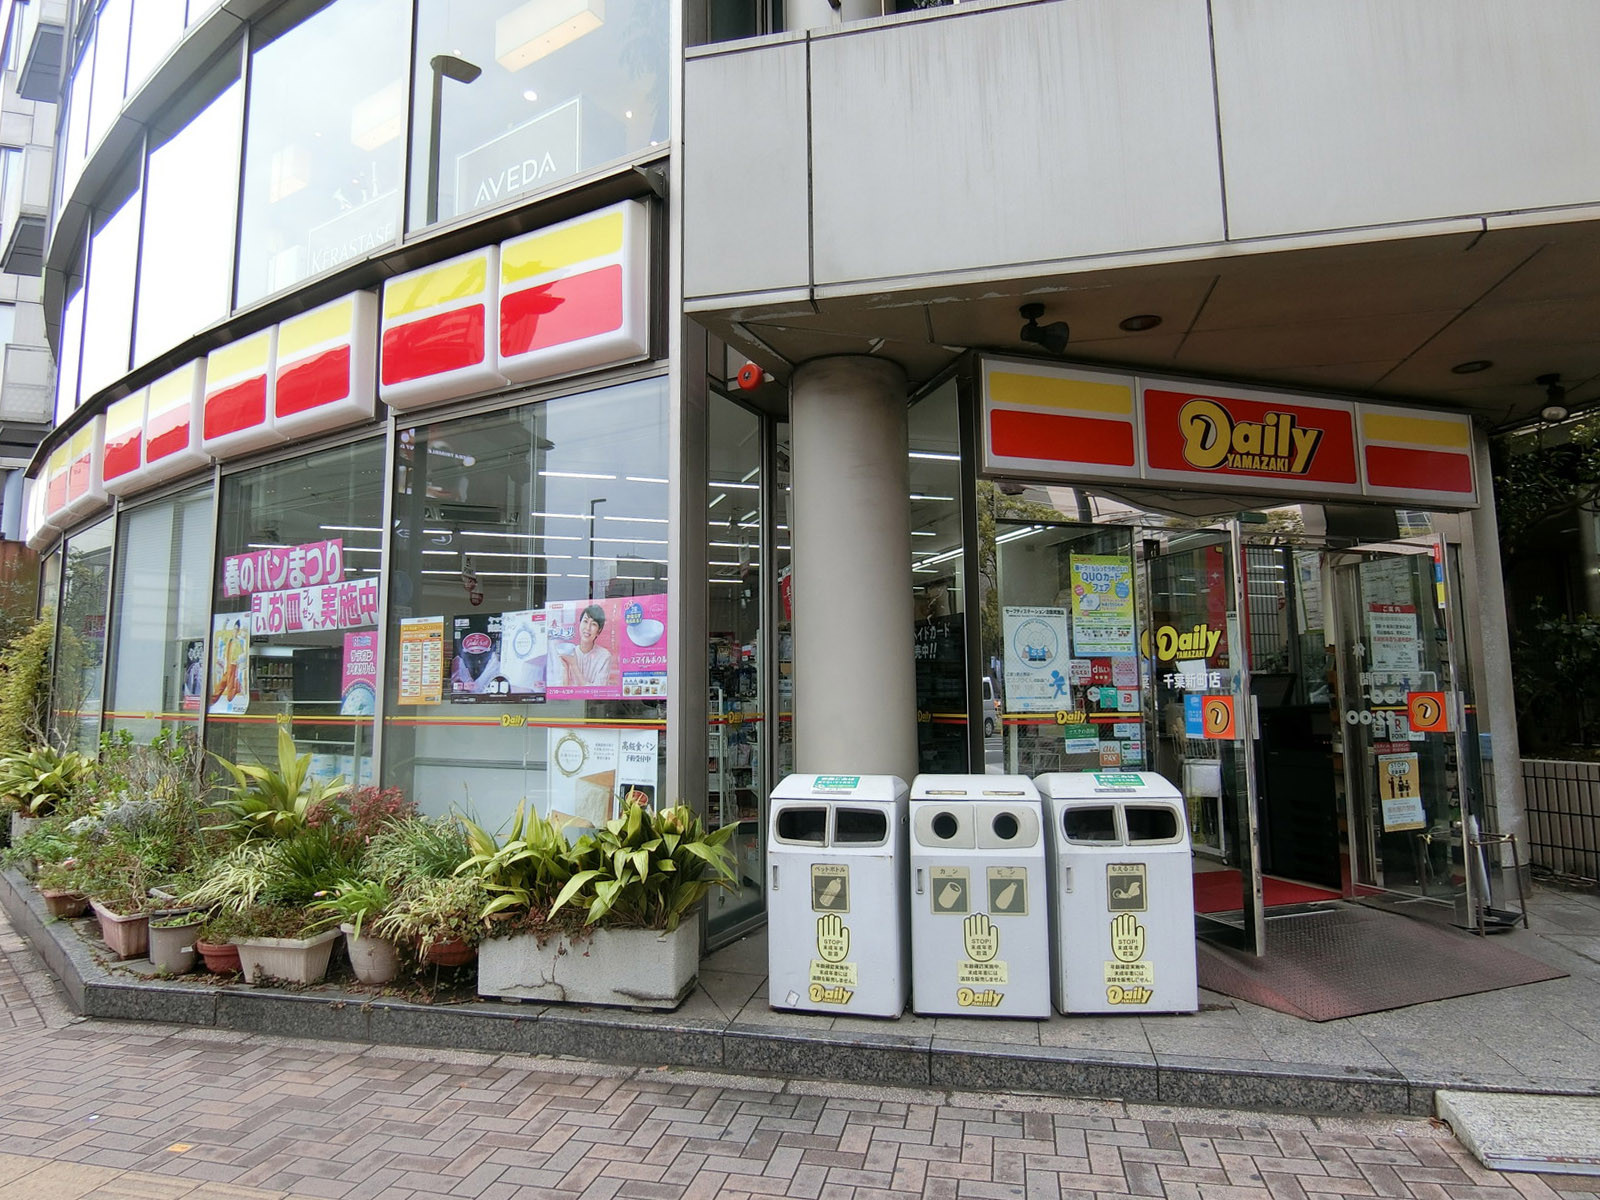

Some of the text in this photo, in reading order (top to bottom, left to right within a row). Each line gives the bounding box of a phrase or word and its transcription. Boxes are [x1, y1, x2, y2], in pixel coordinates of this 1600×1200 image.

[474, 151, 557, 207] AVEDA
[1178, 398, 1325, 475] Daily
[1227, 453, 1289, 472] YAMAZAKI
[225, 541, 341, 596] 春のパンまつり
[1156, 624, 1222, 661] Daily
[1163, 672, 1221, 689] 千葉新町店
[501, 713, 527, 727] Daily
[1056, 710, 1087, 724] Daily
[621, 741, 656, 752] 高級食パン
[814, 865, 846, 873] ペットボトル
[808, 983, 853, 1004] Daily
[957, 987, 1004, 1007] Daily
[1106, 985, 1153, 1005] Daily
